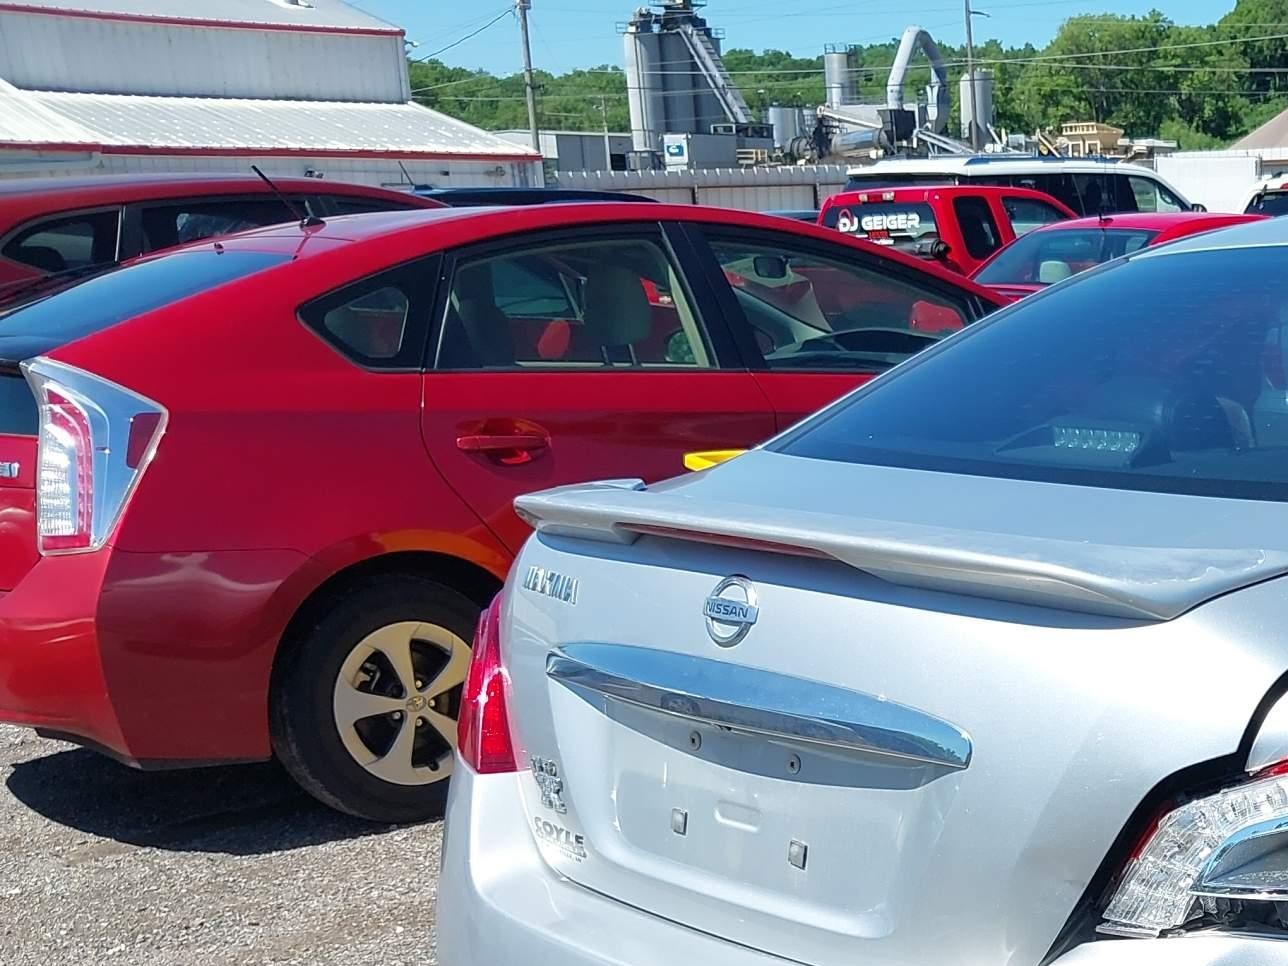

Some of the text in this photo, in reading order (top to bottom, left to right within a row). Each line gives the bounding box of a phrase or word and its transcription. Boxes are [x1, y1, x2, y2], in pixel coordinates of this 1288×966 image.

[838, 213, 920, 232] DJ GEIGER
[707, 601, 749, 618] NISSAN
[534, 816, 584, 846] COYLE
